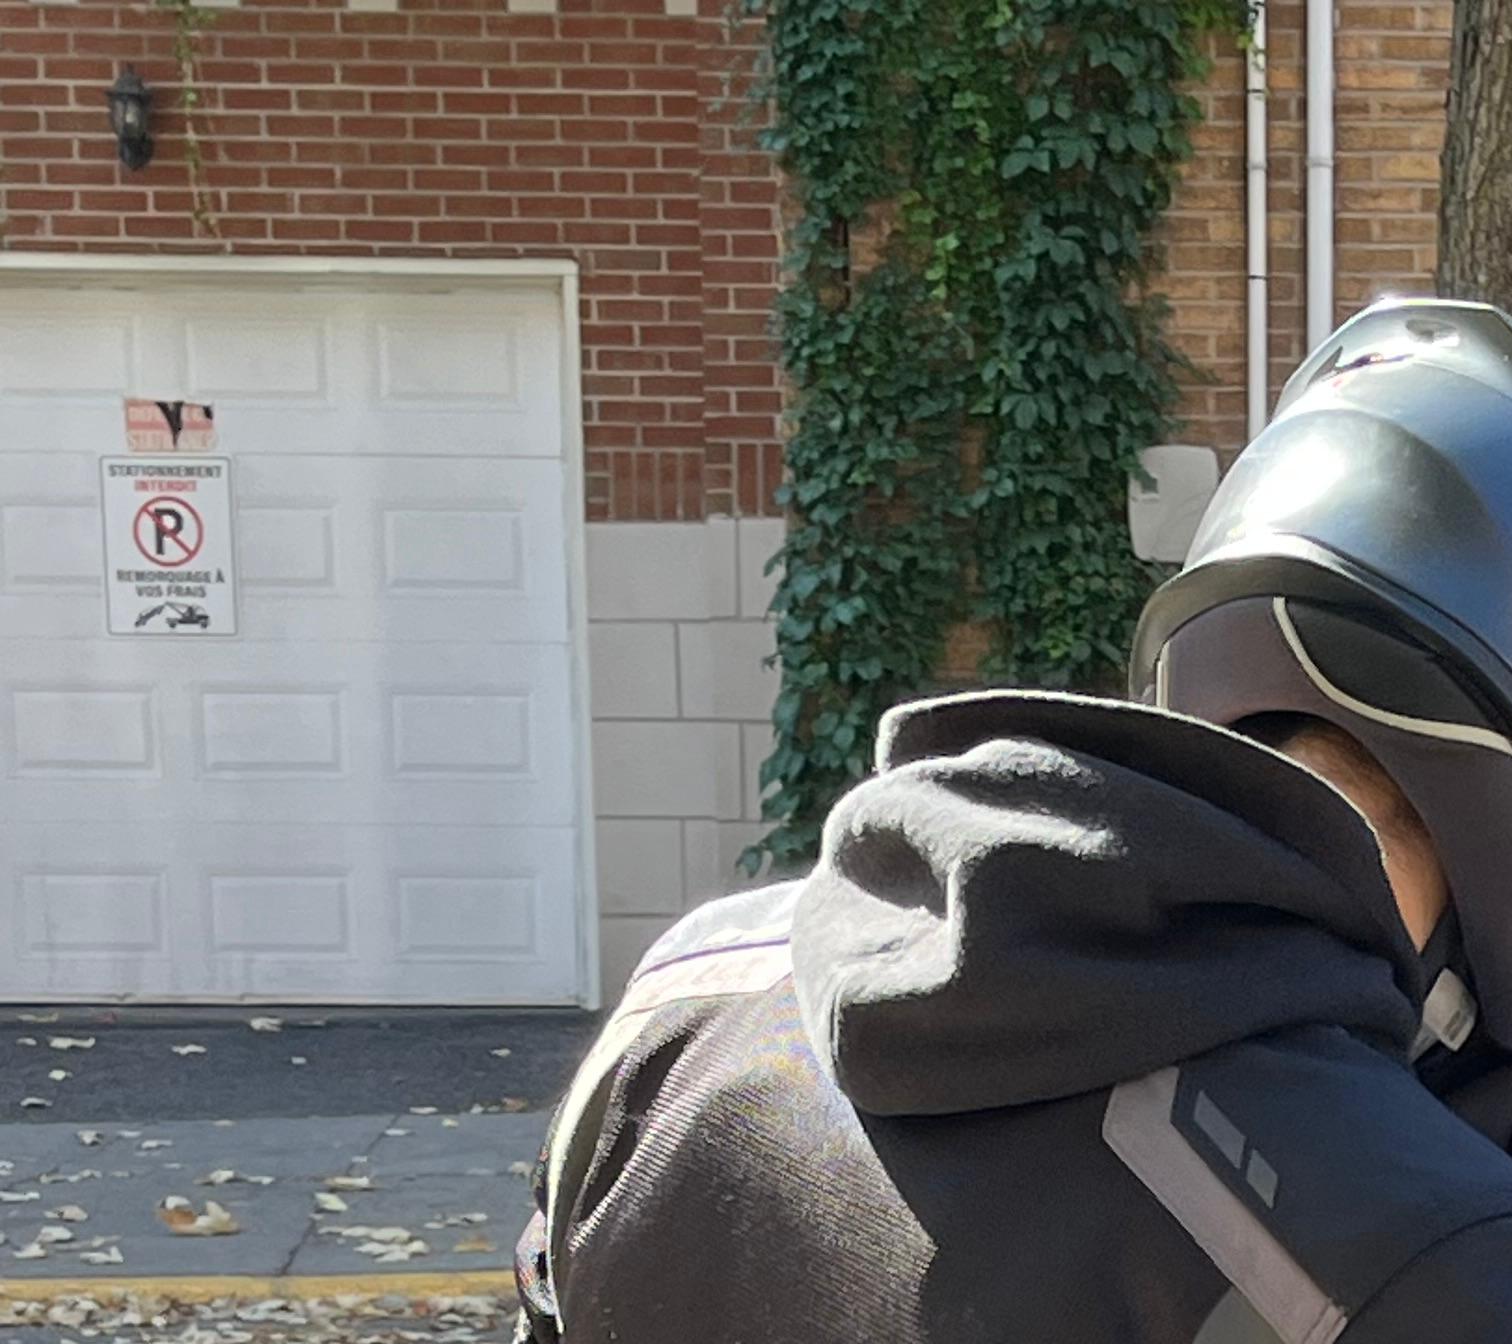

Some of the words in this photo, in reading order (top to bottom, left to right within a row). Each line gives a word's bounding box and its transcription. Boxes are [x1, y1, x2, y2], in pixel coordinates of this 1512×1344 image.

[108, 465, 222, 478] STATIONNEMENT
[134, 480, 197, 492] INTERDIT
[116, 570, 212, 583] REMORQUAGE
[215, 568, 225, 583] À
[135, 586, 164, 598] VOS
[167, 585, 207, 598] FRAIS
